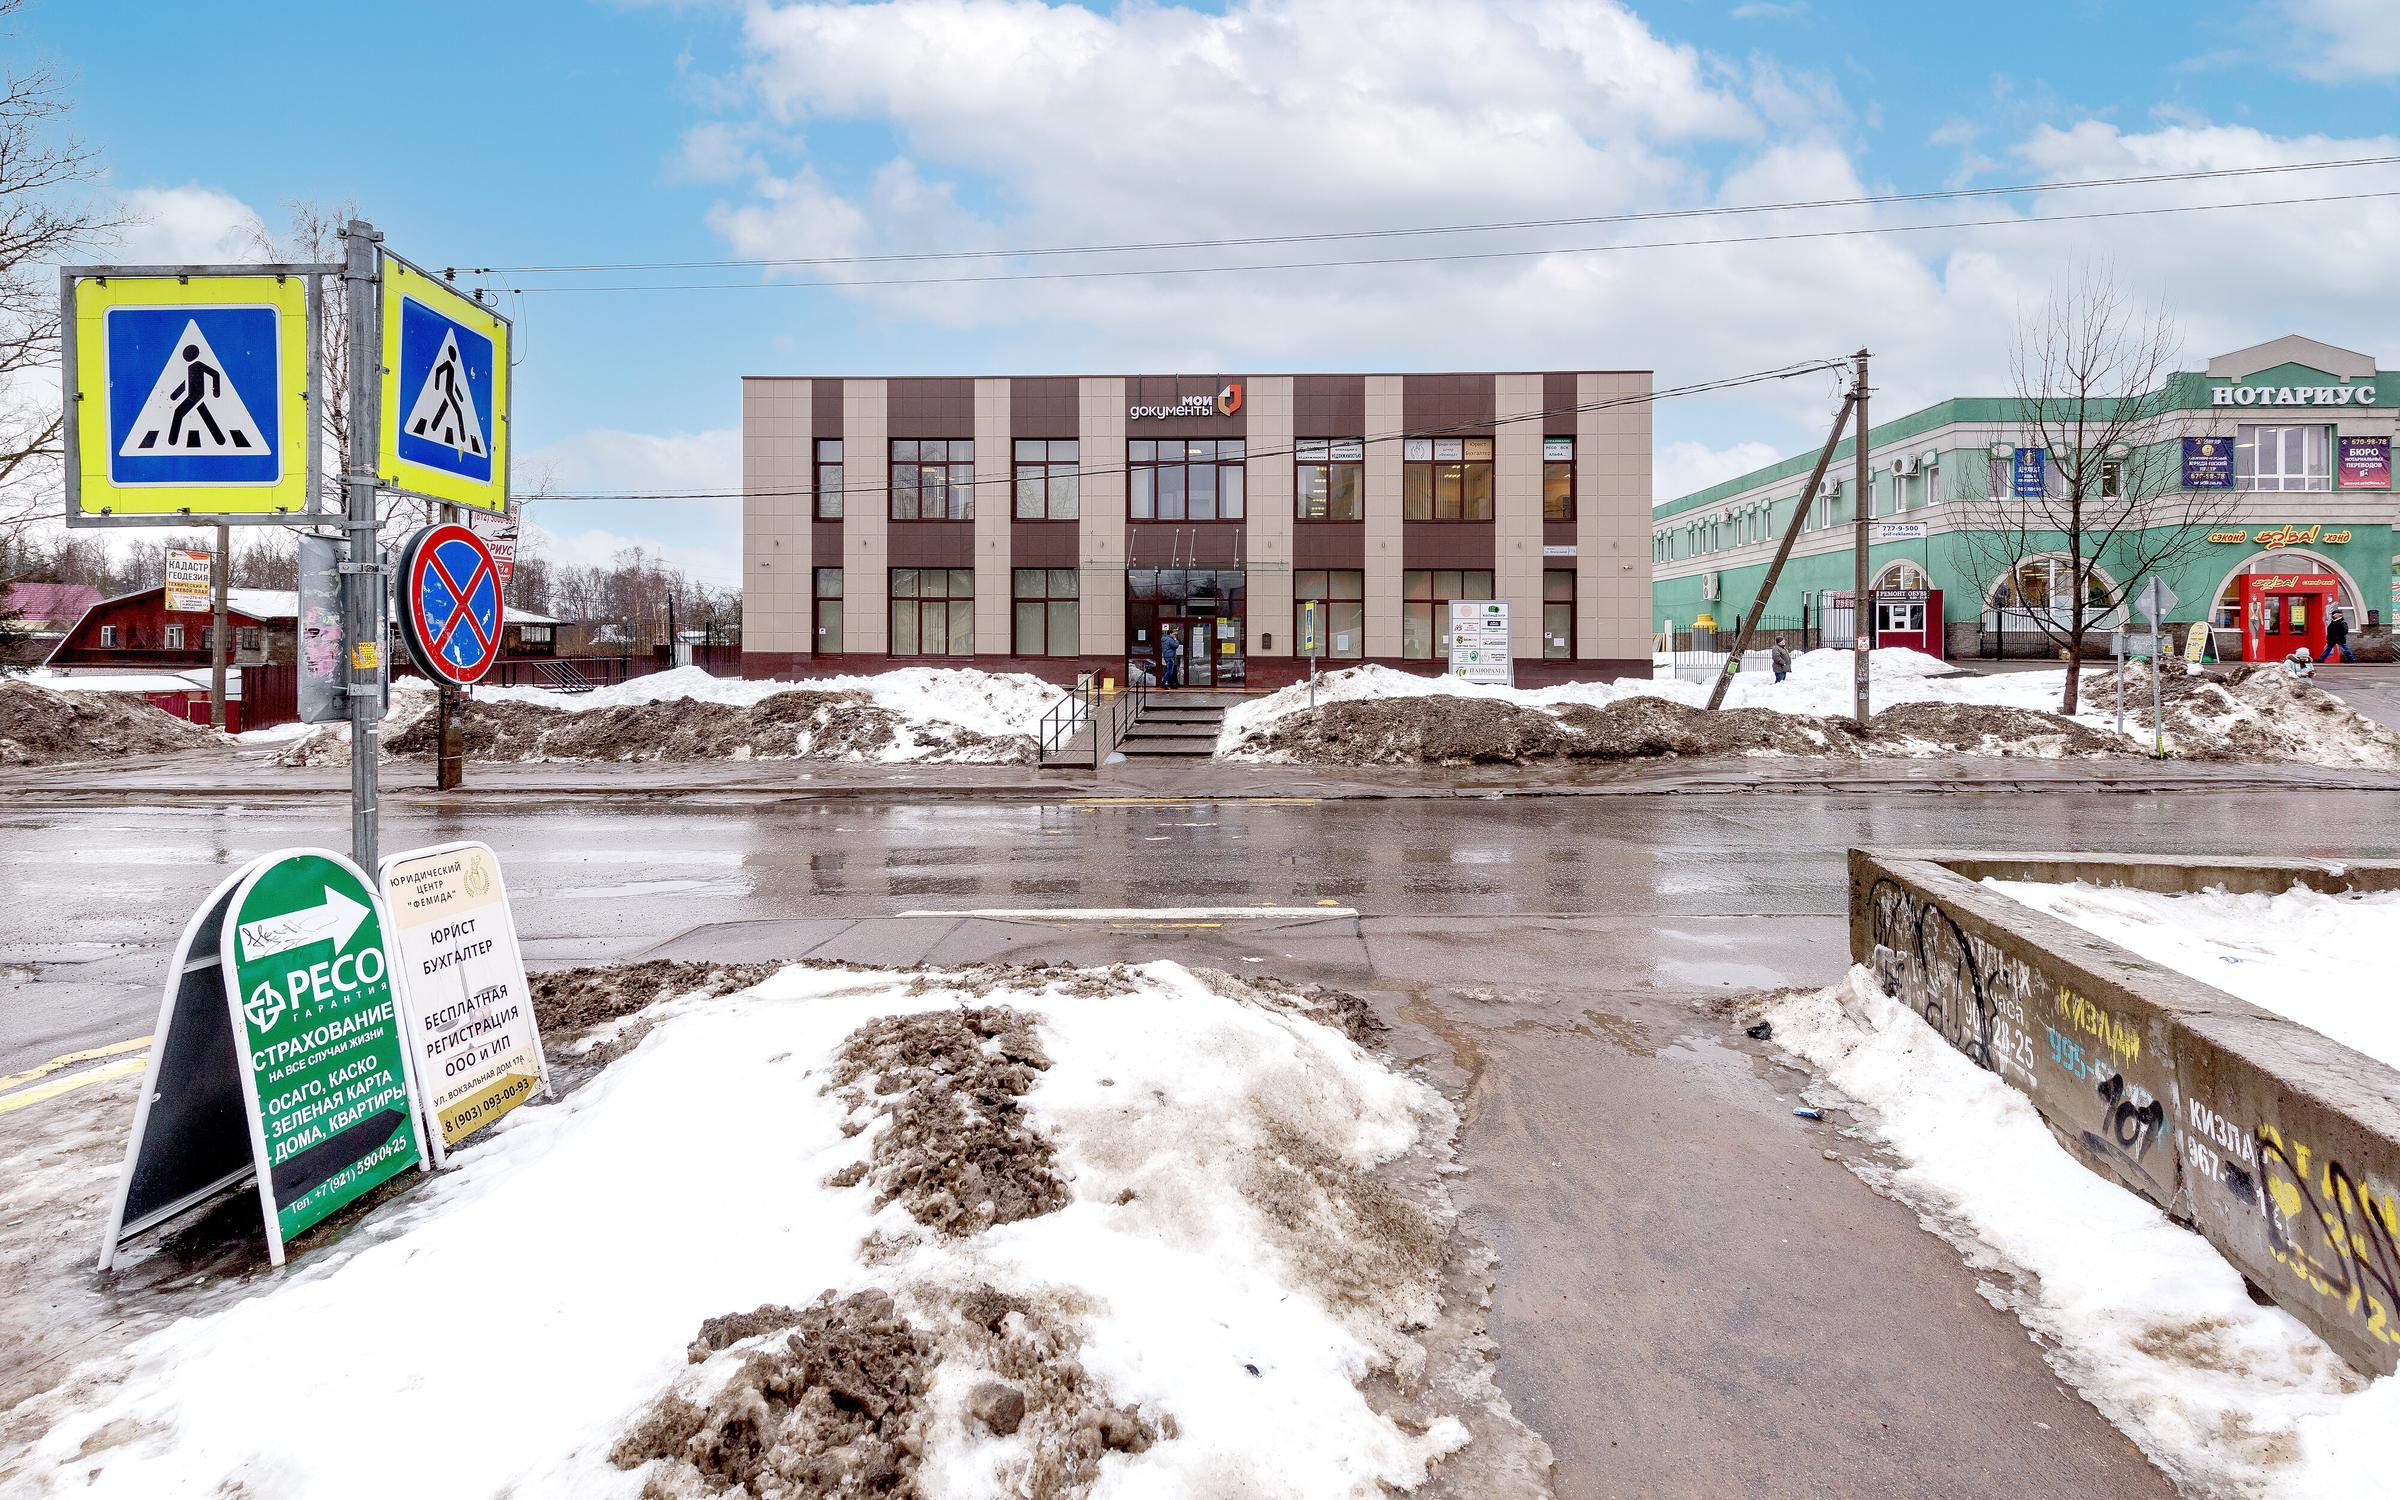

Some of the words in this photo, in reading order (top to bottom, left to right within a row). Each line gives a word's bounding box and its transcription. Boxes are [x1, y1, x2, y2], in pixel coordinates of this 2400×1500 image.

[2212, 386, 2376, 405] НОТАРИУС
[2350, 448, 2378, 456] БЮРО
[168, 572, 208, 581] ГЕОДЕЗИЯ
[169, 561, 208, 572] КАДАСТР
[390, 862, 462, 888] ЮРИДИЧЕСКИЙ
[416, 880, 444, 895] ЦЕНТР
[407, 889, 456, 909] "ФЕМИДА"
[430, 919, 475, 946] ЮРИСТ
[423, 939, 493, 975] БУХГАЛТЕР
[286, 947, 385, 1010] РЕСО
[293, 982, 387, 1022] ГАРАНТИЯ
[424, 984, 508, 1031] БЕСПЛАТНАЯ
[252, 1001, 394, 1072] СТРАХОВАНИЕ
[426, 1005, 519, 1059] РЕГИСТРАЦИЯ
[269, 1069, 284, 1083] НА
[286, 1062, 306, 1076] ВСЕ
[349, 1027, 384, 1048] ЖИЗНИ
[445, 1052, 476, 1077] ООО
[491, 1035, 511, 1054] ИП
[268, 1079, 326, 1116] ОСАГО,
[328, 1055, 377, 1089] КАСКО
[448, 1069, 496, 1100] ВОКЗАЛЬНАЯ
[496, 1062, 512, 1078] ДОМ
[271, 1090, 344, 1138] ЗЕЛЕНАЯ
[346, 1069, 392, 1099] КАРТА
[275, 1125, 326, 1164] ДОМА,
[328, 1082, 406, 1133] КВАРТИРЫ
[445, 1120, 453, 1133] 8
[454, 1104, 482, 1130] (903)
[483, 1078, 530, 1112] 093-00-93
[290, 1196, 313, 1214] Тел.
[314, 1184, 327, 1199] +7
[330, 1168, 356, 1194] (921)
